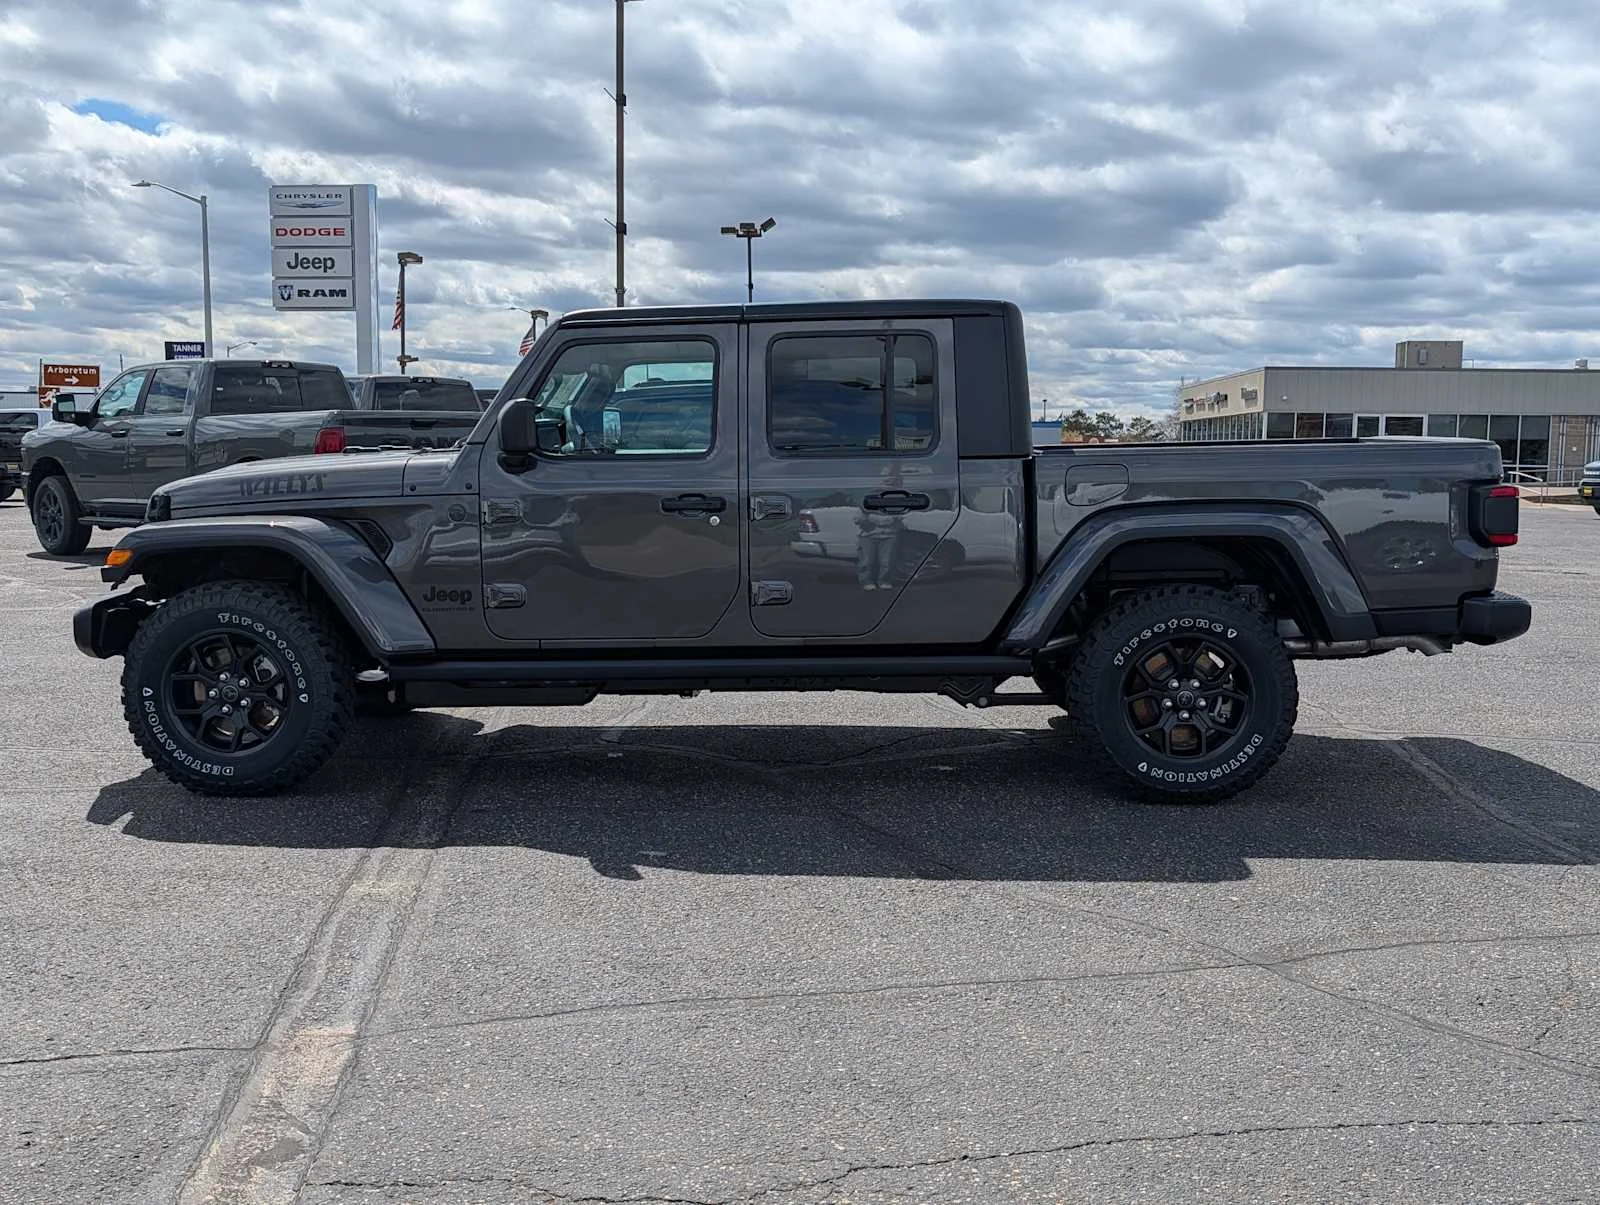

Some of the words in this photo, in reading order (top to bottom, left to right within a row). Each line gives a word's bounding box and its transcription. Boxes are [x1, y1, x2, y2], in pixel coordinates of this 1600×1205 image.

[275, 228, 345, 237] DODGE
[286, 252, 336, 273] Jeep
[297, 289, 347, 298] RAM
[172, 344, 202, 352] TANNER
[47, 366, 97, 375] Arboretum
[422, 585, 473, 605] Jeep
[143, 700, 234, 777] DESTINATION
[1150, 733, 1264, 783] DESTINATION
